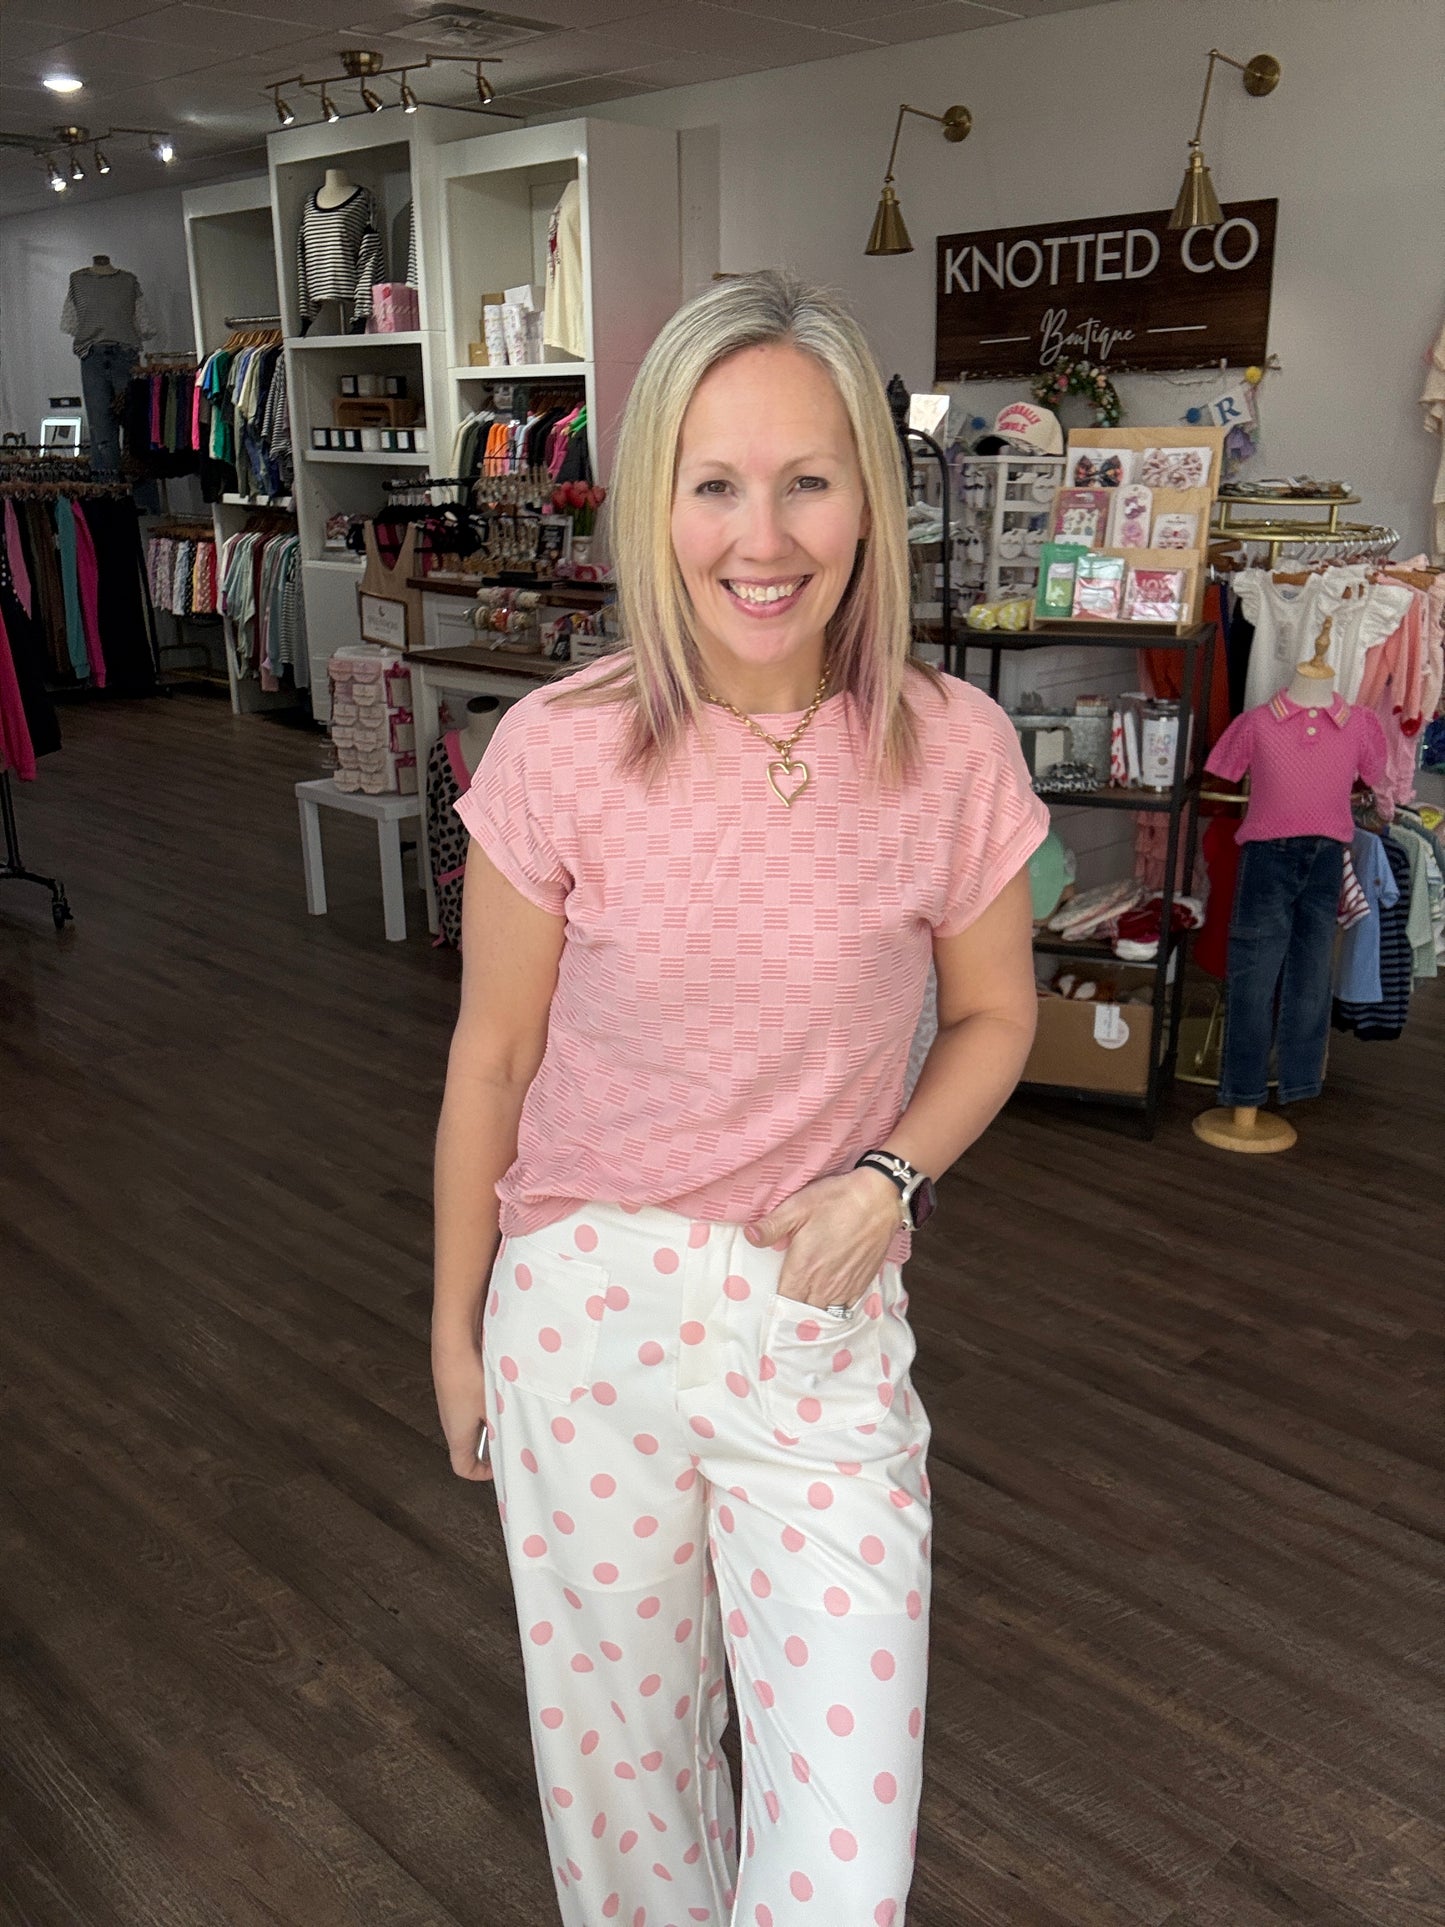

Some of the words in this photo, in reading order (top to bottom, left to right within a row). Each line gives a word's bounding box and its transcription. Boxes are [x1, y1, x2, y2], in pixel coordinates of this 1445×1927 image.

[944, 227, 1161, 295] KNOTTED
[1180, 217, 1260, 274] CO
[1039, 308, 1136, 367] Boutique
[1215, 396, 1242, 424] R
